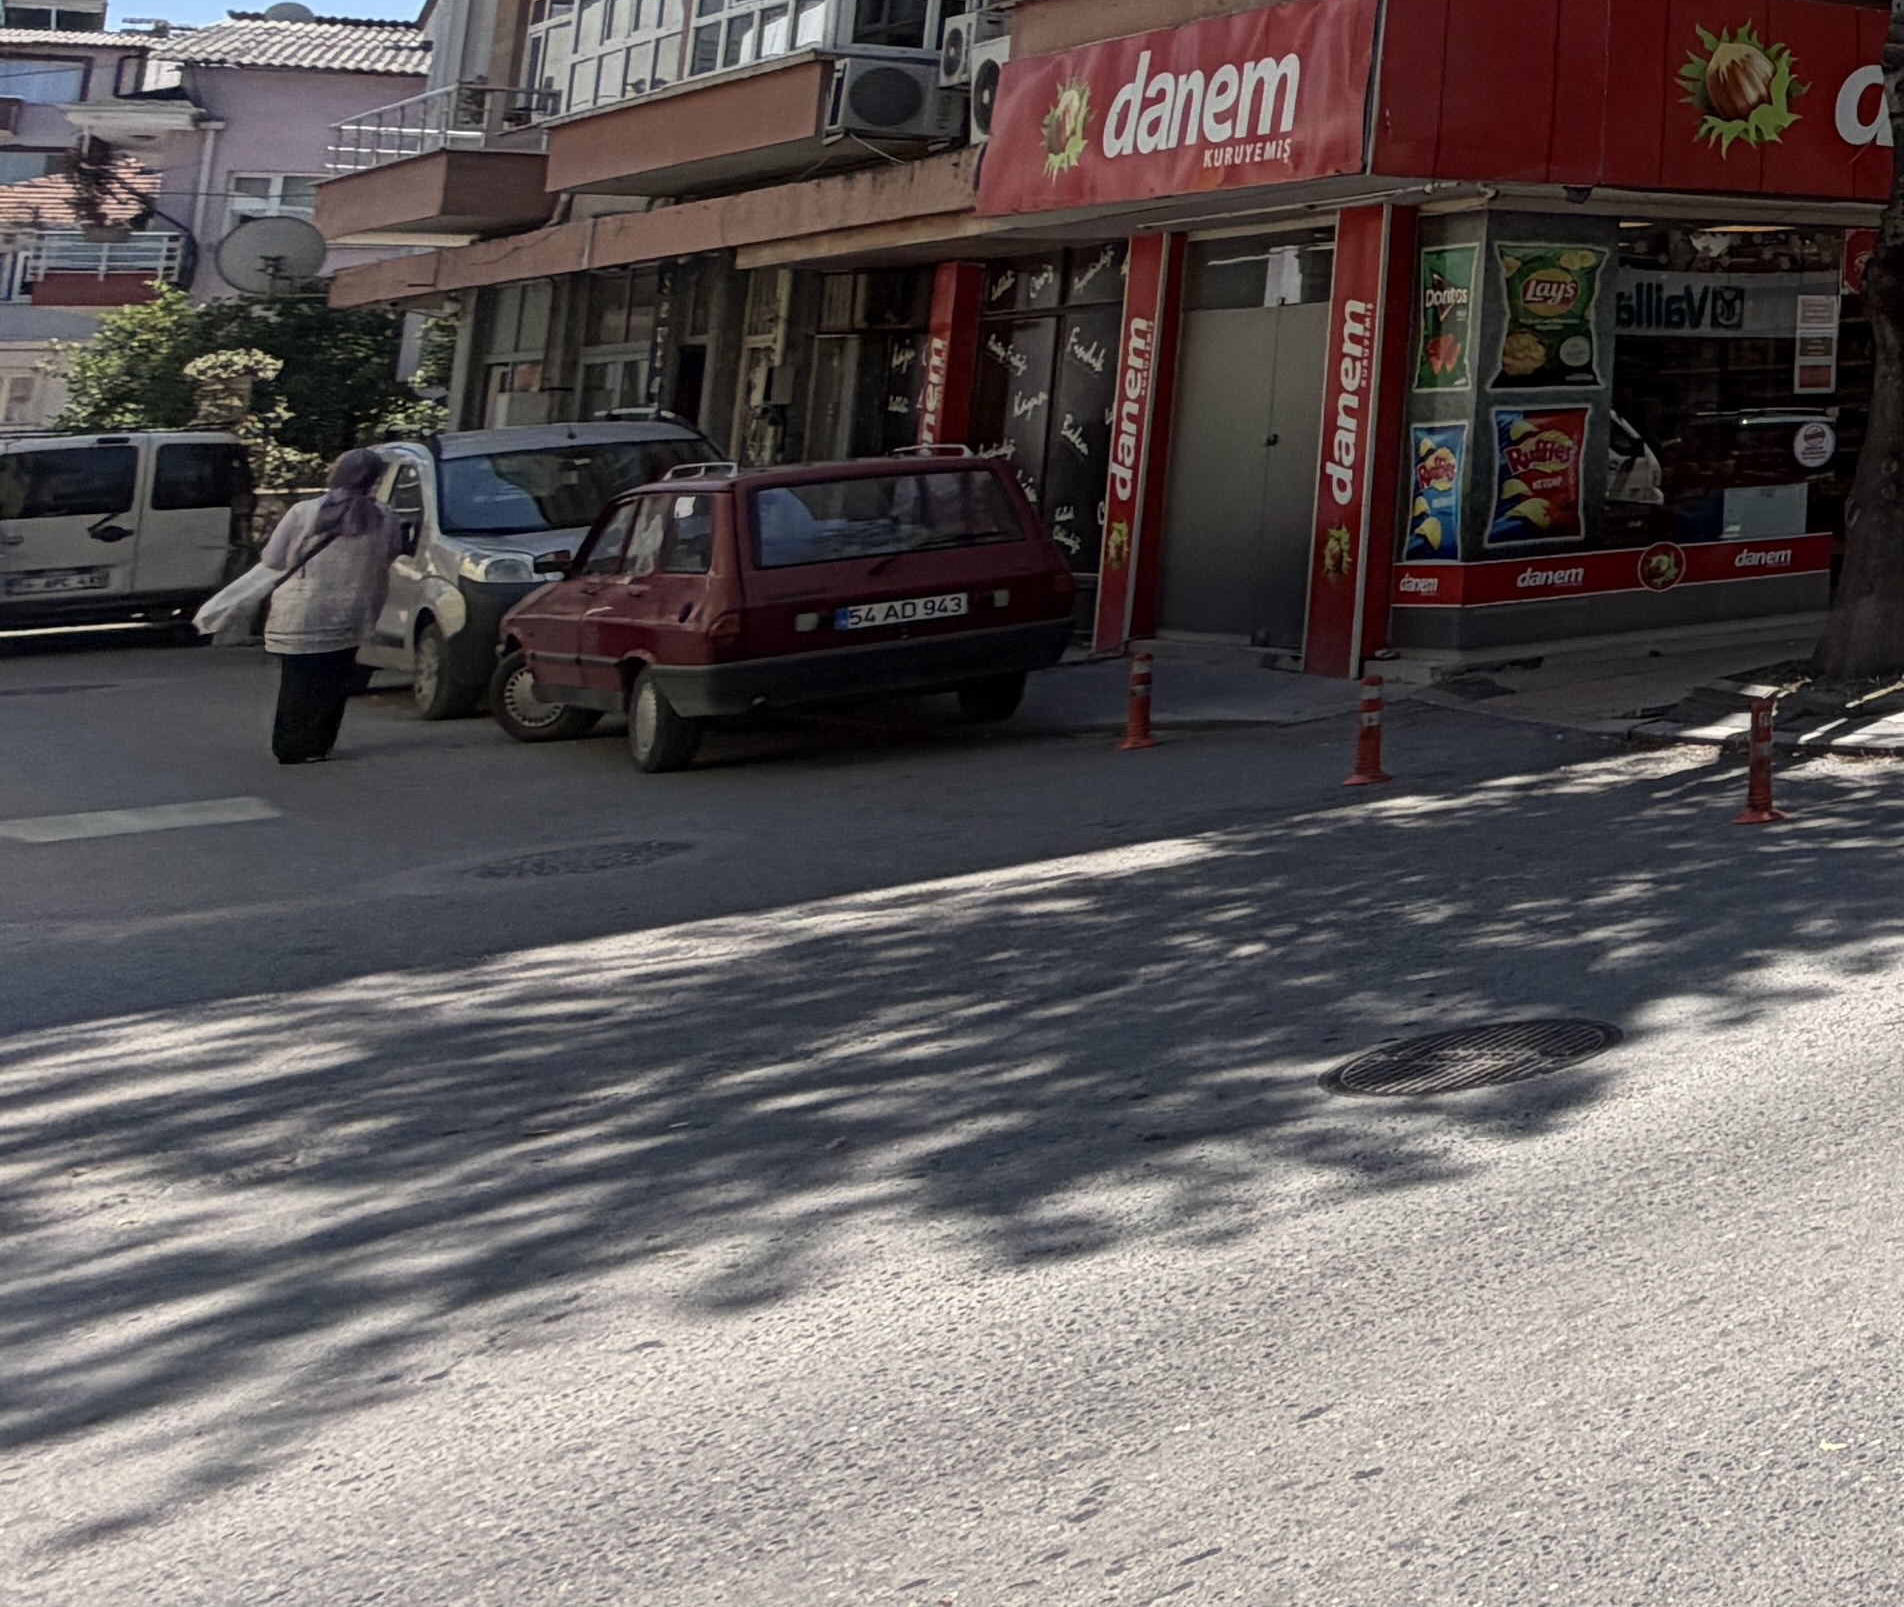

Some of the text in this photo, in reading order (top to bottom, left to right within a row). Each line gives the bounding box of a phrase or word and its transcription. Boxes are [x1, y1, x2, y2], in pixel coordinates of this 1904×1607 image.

[1103, 50, 1301, 159] danem
[1424, 288, 1469, 308] Doritos
[918, 337, 949, 456] nem
[1110, 316, 1148, 502] danem
[1325, 298, 1367, 506] danem
[1735, 547, 1793, 569] danem
[1400, 573, 1438, 594] danem
[1516, 565, 1586, 588] danem
[849, 596, 963, 625] 54 AD 943
